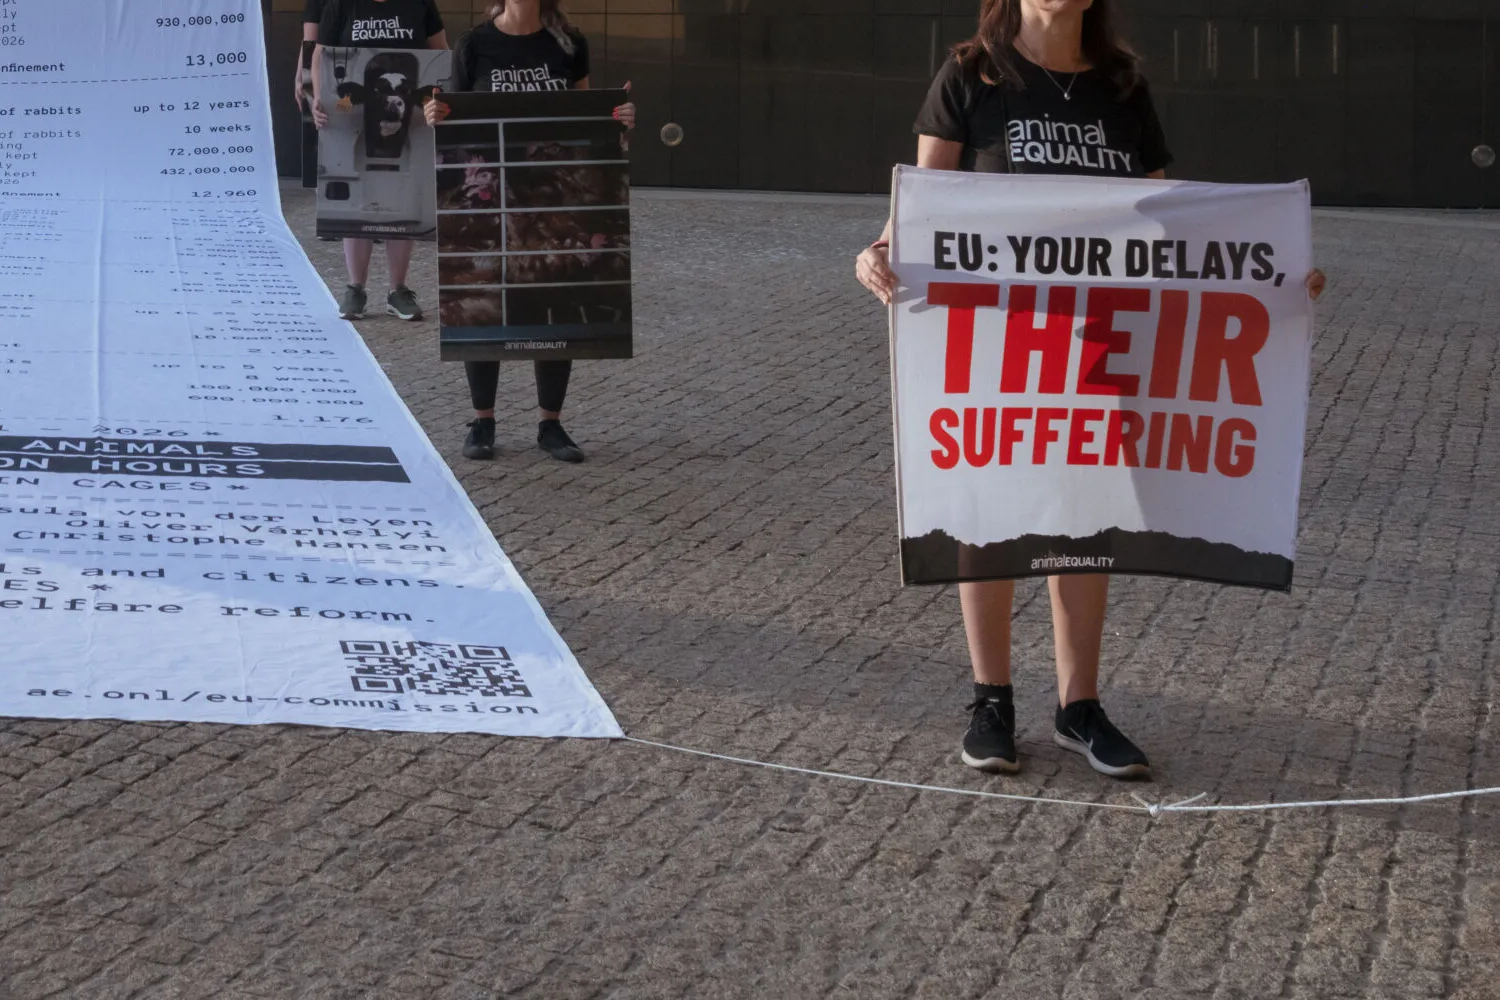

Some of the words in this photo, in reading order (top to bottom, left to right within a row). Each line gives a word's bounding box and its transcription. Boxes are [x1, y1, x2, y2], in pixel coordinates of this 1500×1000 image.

[155, 12, 245, 28] 930,000,000
[352, 16, 399, 29] animal
[352, 29, 413, 41] EQUALITY
[186, 51, 247, 67] 13,000
[492, 64, 550, 82] animal
[1008, 113, 1106, 145] animal
[168, 145, 254, 157] 72,000,000
[1010, 142, 1132, 172] EQUALITY
[160, 165, 255, 176] 432,000,000
[934, 231, 998, 272] EU:
[1007, 236, 1112, 276] YOUR
[1125, 238, 1285, 287] DELAYS,
[927, 282, 1270, 406] THEIR
[92, 425, 189, 437] 2026
[21, 439, 260, 456] ANIMALS
[929, 408, 1257, 478] SUFFERING
[92, 460, 264, 474] HOURS
[72, 478, 212, 491] CAGES
[117, 510, 186, 518] von
[214, 511, 285, 523] der
[312, 515, 435, 529] Leyen
[12, 530, 265, 546] Christophe
[294, 539, 447, 553] Hansen
[1031, 553, 1114, 569] animalEQUALITY
[81, 567, 165, 578] and
[202, 570, 464, 589] citizens.
[220, 606, 435, 623] reform.
